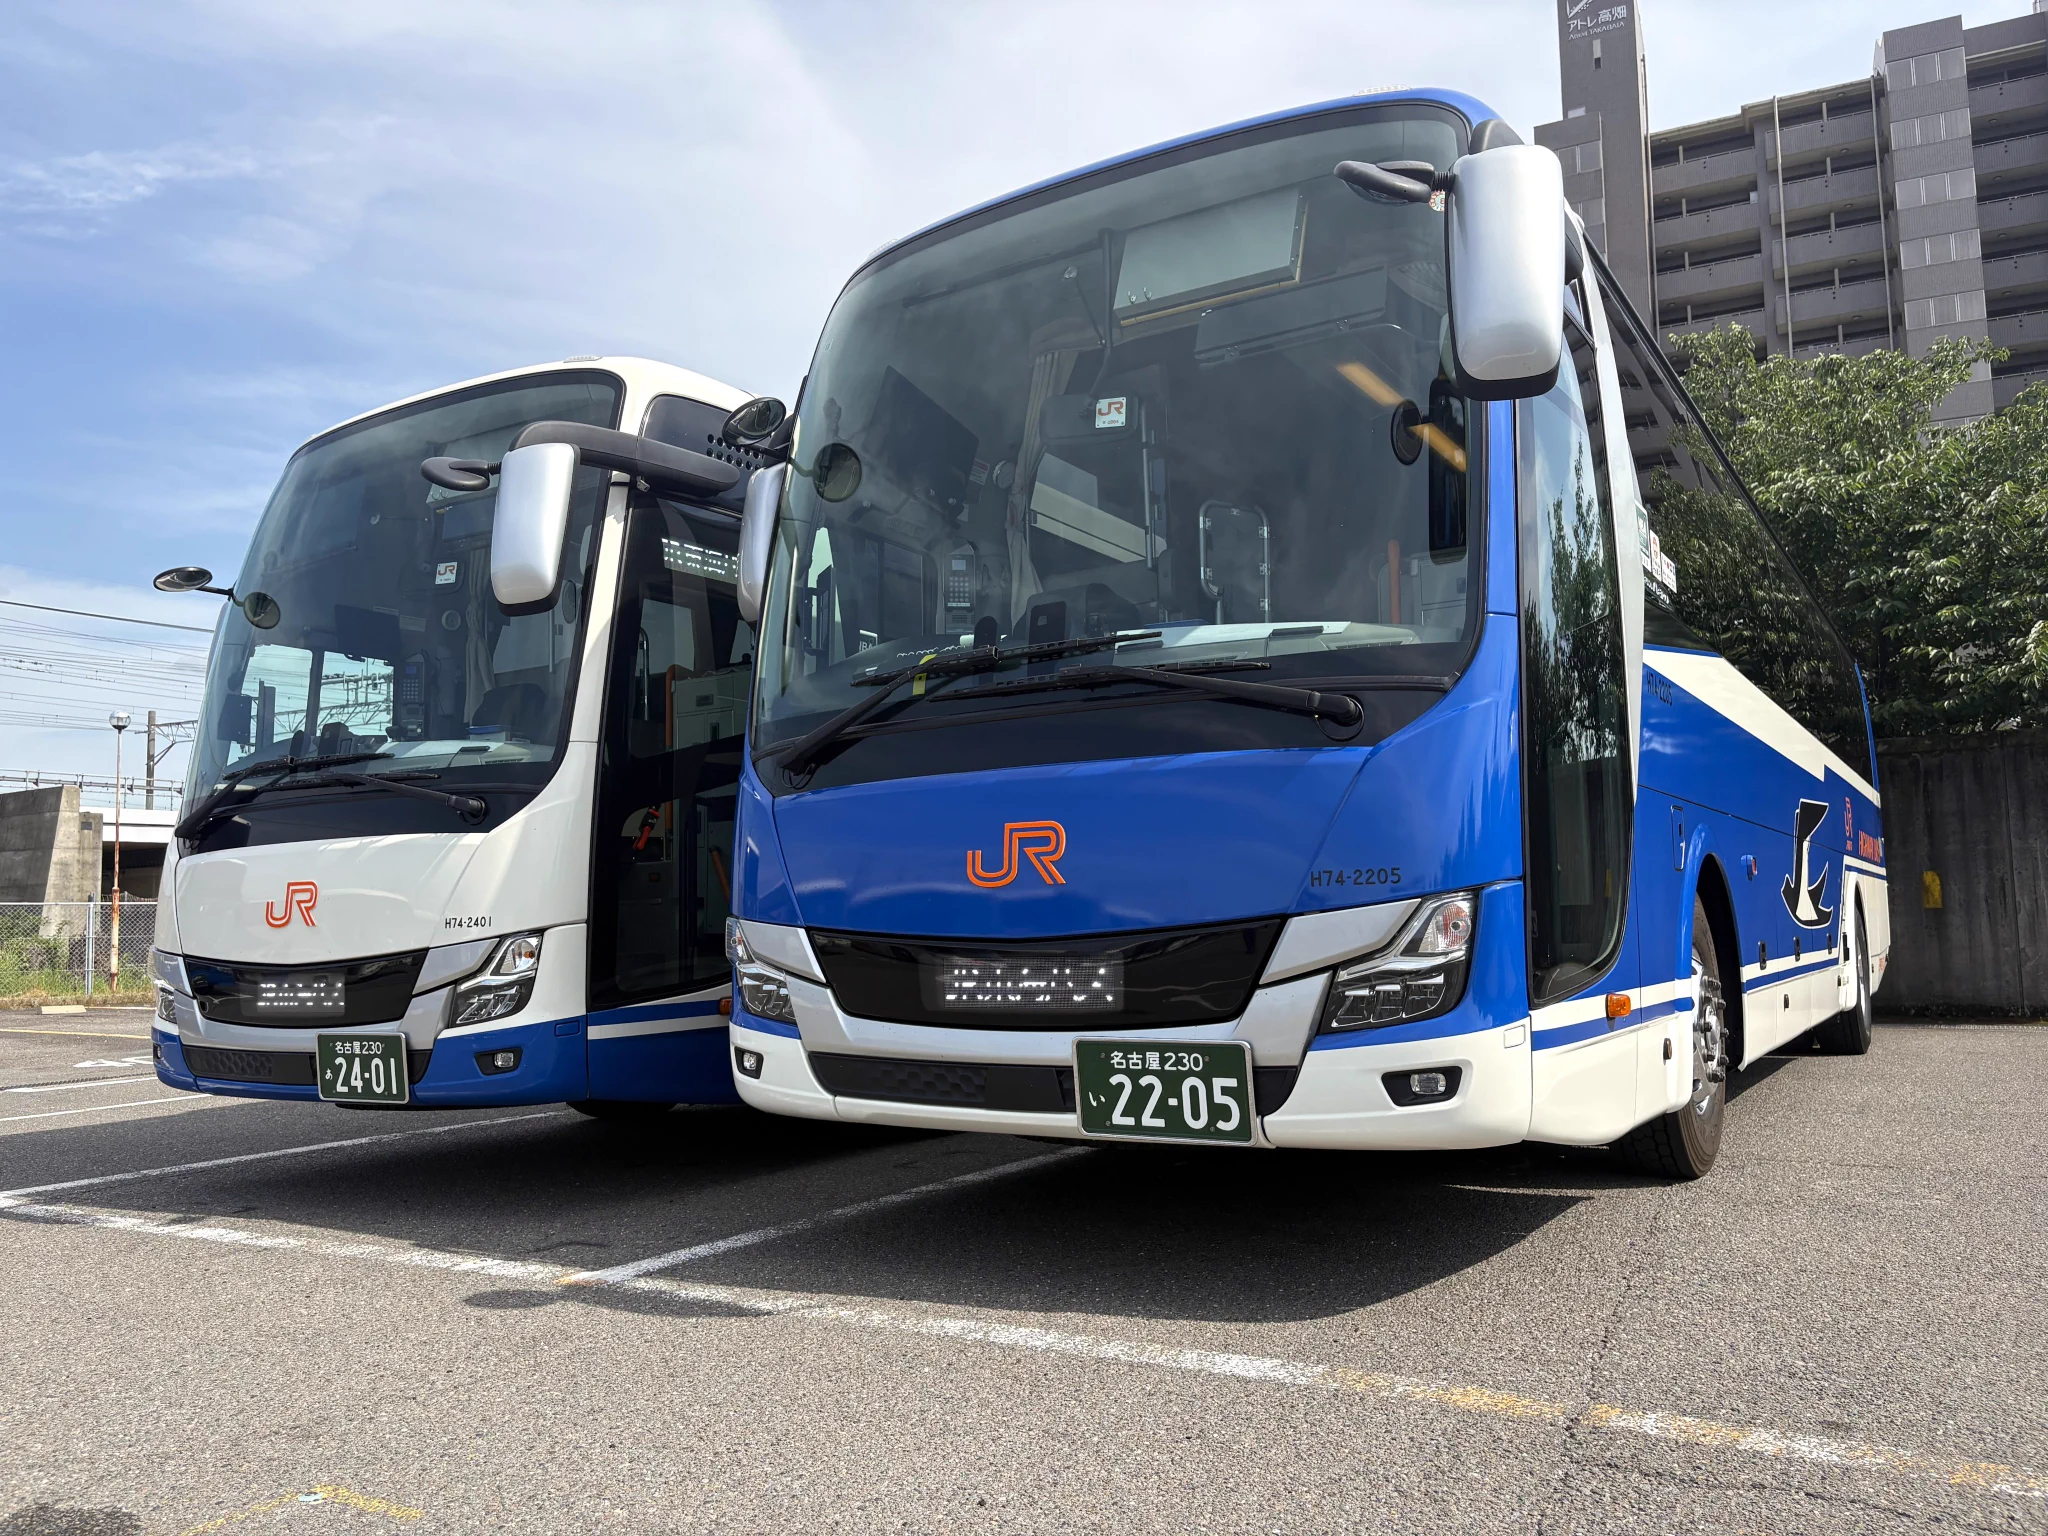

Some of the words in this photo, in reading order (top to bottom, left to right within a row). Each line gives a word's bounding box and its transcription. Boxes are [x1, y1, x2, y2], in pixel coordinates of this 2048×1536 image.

[1566, 5, 1627, 32] アトレ高畑
[1097, 400, 1124, 417] JR
[437, 564, 456, 576] JR
[966, 820, 1067, 888] JR
[1310, 867, 1402, 887] H74-2205
[265, 880, 319, 929] JR
[444, 915, 492, 929] H74-2401
[334, 1056, 397, 1095] 24-01
[1088, 1091, 1106, 1107] い
[1109, 1073, 1241, 1132] 22-05
